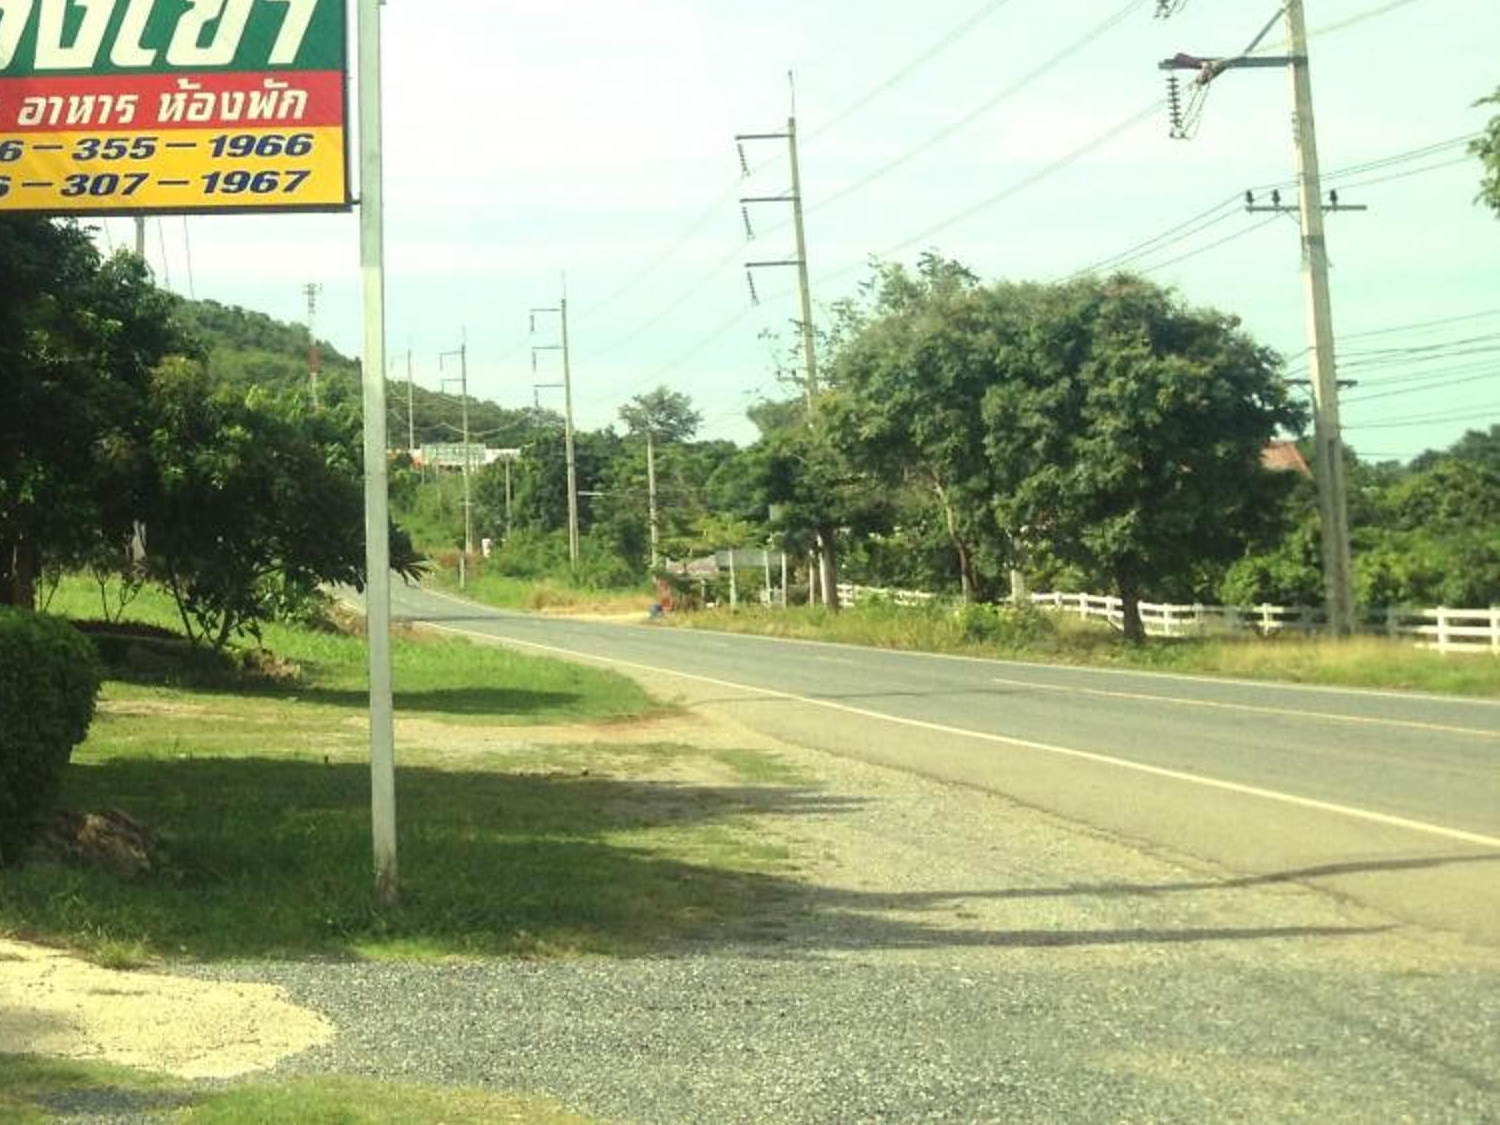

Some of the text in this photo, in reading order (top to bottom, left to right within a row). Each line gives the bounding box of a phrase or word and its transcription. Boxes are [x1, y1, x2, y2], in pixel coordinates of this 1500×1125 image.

[18, 94, 138, 127] อาหาร
[157, 78, 309, 123] ห้องพัก
